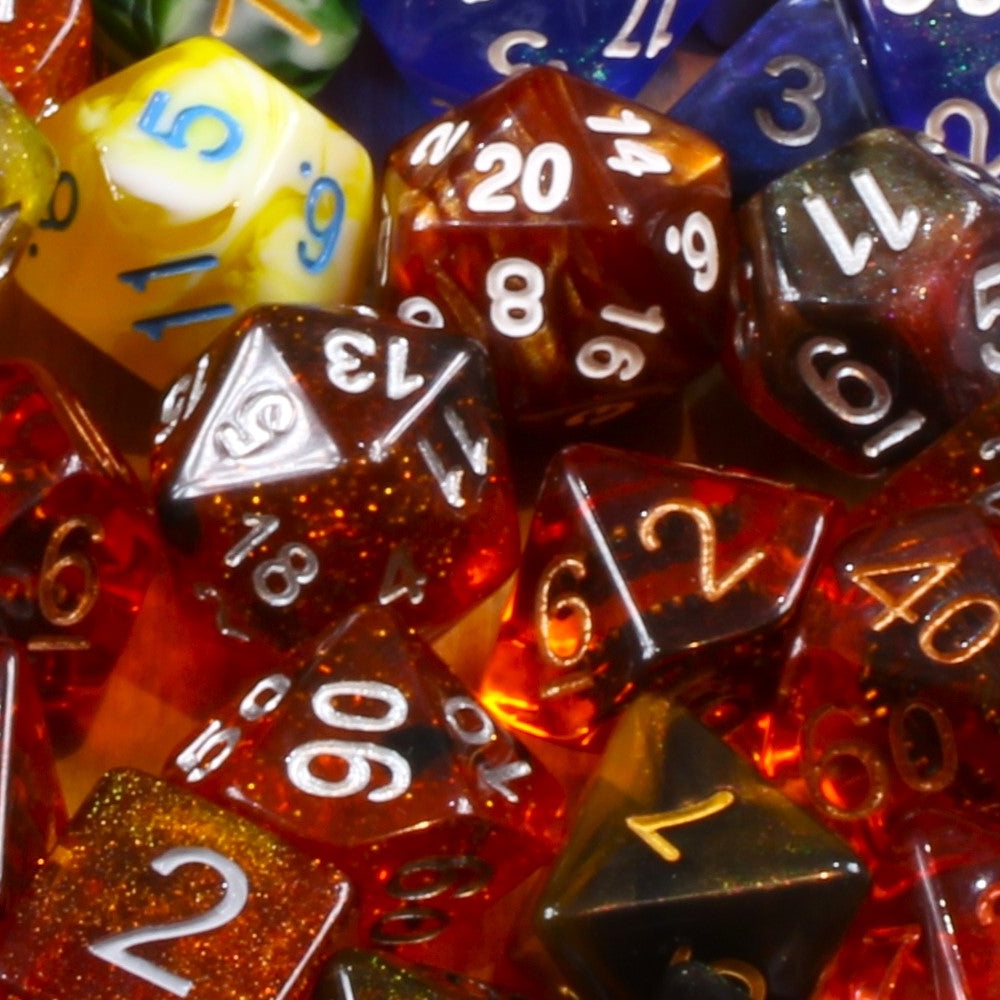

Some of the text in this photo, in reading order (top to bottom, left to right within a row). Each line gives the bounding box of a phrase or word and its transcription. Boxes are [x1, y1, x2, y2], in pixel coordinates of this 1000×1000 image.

[137, 90, 244, 163] 5
[585, 107, 673, 178] 14
[754, 54, 826, 148] 3
[467, 142, 573, 213] 20
[803, 167, 921, 276] 11
[118, 254, 237, 341] 11
[486, 256, 545, 338] 8
[323, 328, 424, 401] 13
[213, 390, 296, 458] 5
[416, 407, 488, 508] 11
[224, 513, 319, 606] 18
[638, 502, 766, 602] 2
[850, 556, 1000, 664] 40
[87, 846, 249, 999] 2
